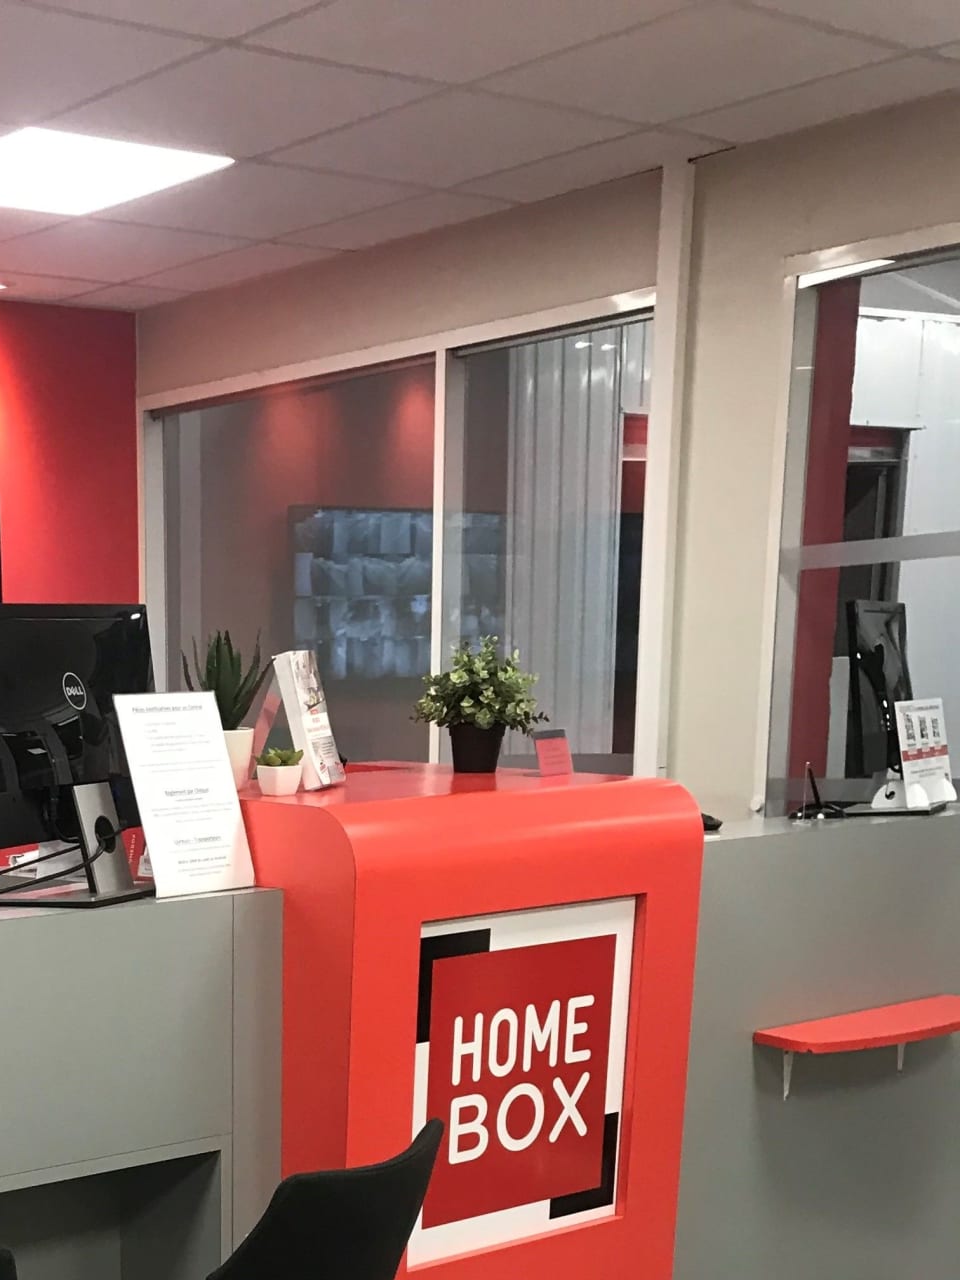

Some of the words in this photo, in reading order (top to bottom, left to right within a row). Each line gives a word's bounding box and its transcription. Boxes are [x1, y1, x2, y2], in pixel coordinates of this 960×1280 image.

[66, 686, 84, 696] DELL
[451, 994, 595, 1086] HOME
[448, 1071, 590, 1165] BOX
